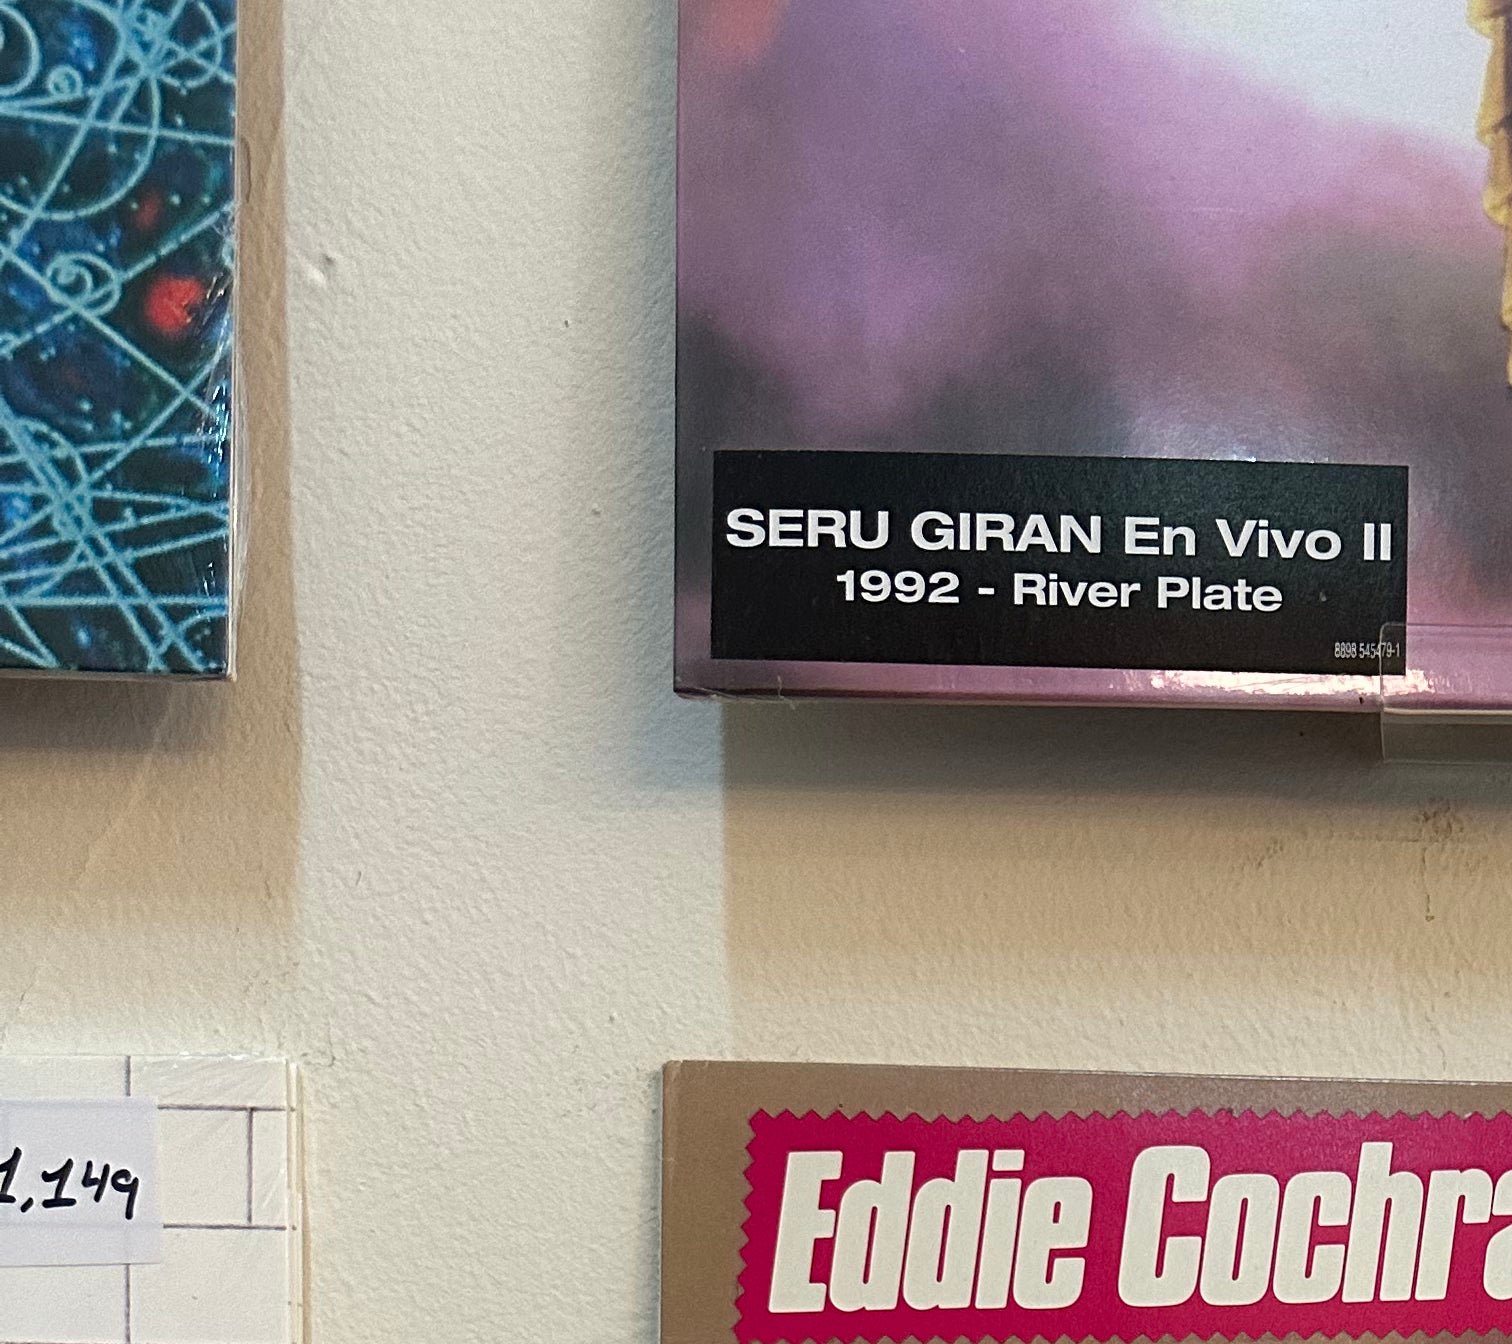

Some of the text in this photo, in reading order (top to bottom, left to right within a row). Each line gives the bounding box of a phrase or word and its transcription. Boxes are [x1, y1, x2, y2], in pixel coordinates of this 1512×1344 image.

[726, 508, 1392, 561] SERU GIRAN En Vivo II
[836, 570, 960, 604] 1992
[1014, 572, 1140, 609] River
[1157, 575, 1283, 613] Plate
[0, 1146, 140, 1220] 1,149
[767, 1148, 1093, 1314] Eddie
